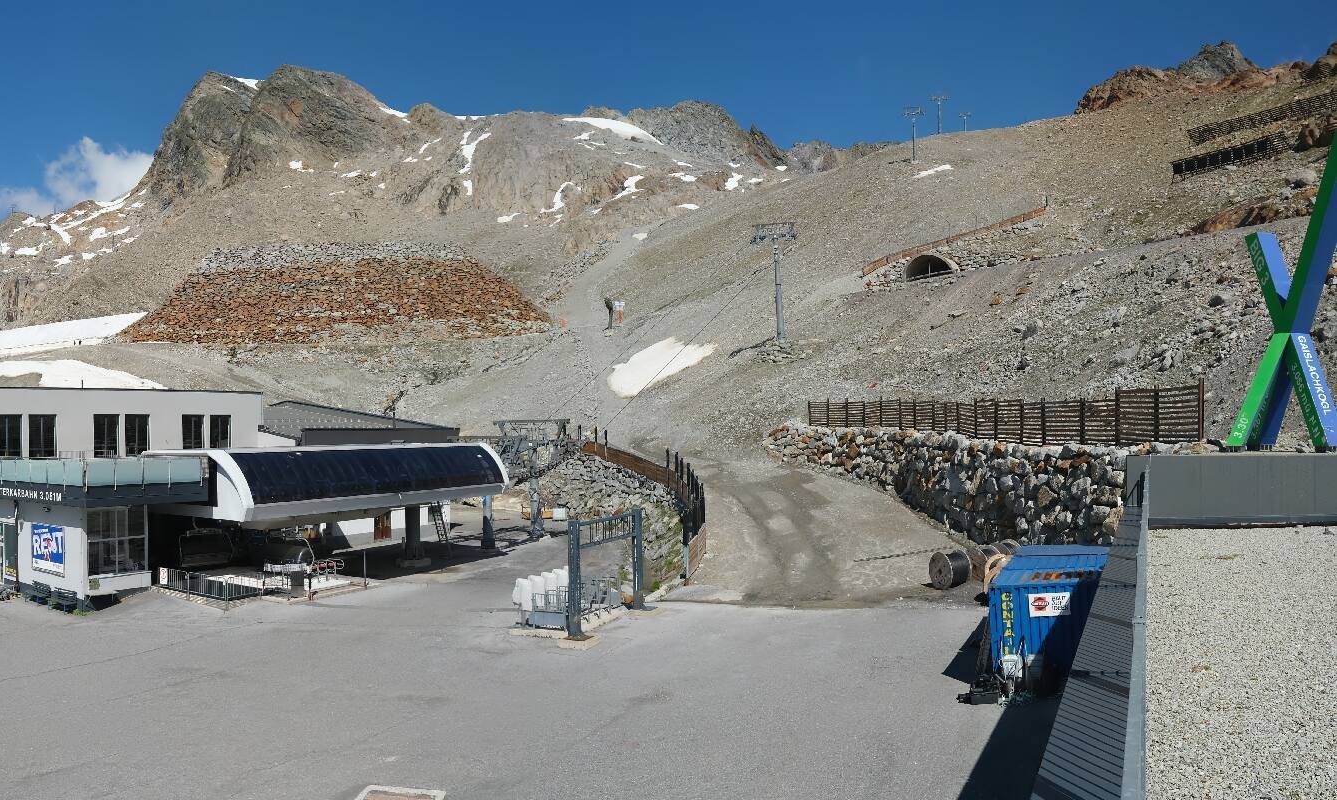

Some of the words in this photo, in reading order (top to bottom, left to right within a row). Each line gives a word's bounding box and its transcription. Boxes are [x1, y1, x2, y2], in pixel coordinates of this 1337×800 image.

[1249, 239, 1265, 272] BIG
[1261, 271, 1270, 286] 3
[1297, 335, 1333, 415] GAISLACHKOGL
